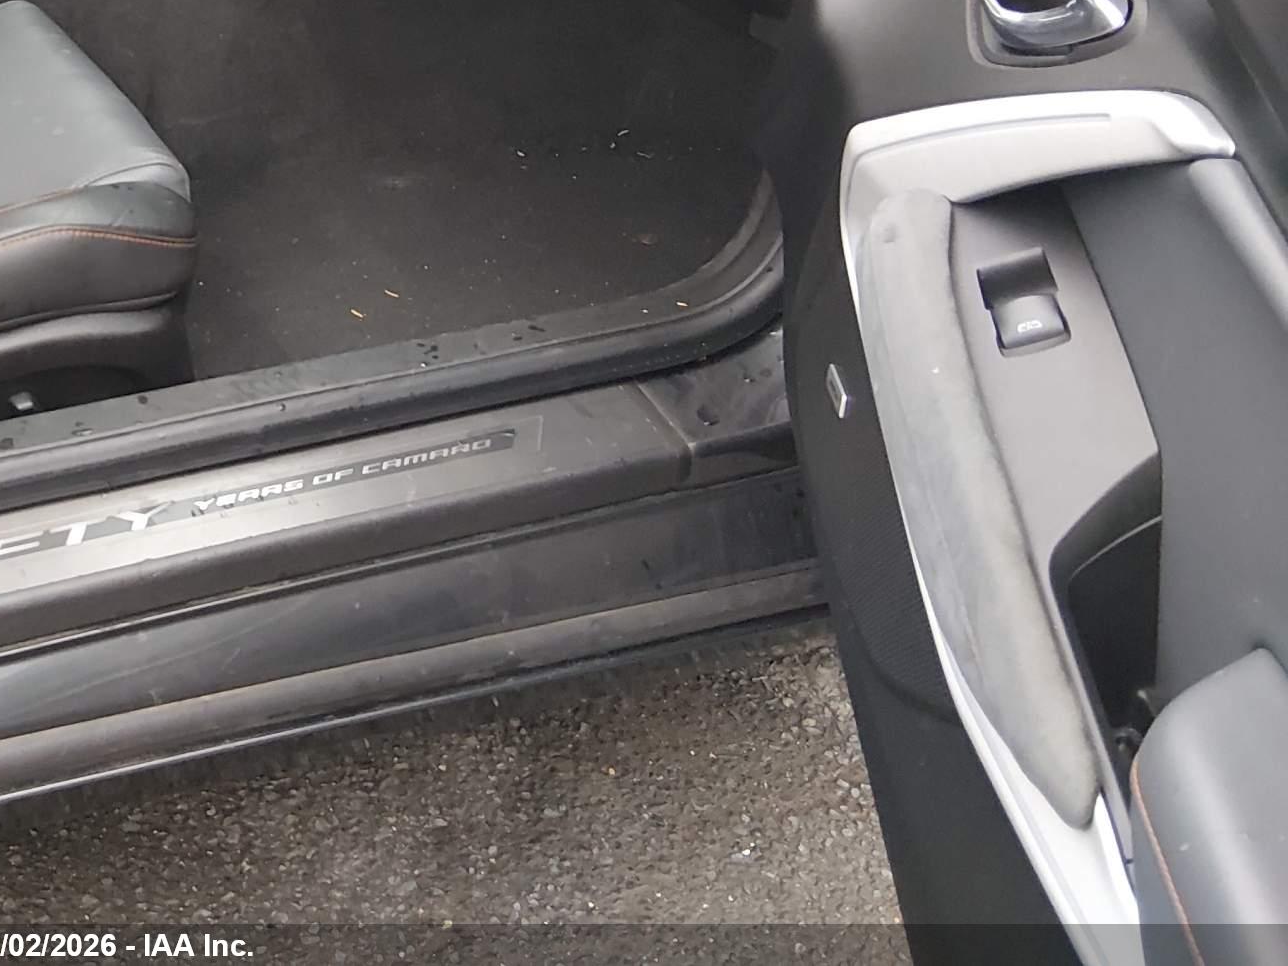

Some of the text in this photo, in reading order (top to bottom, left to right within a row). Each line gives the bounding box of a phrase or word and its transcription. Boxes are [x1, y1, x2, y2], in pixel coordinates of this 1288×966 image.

[193, 478, 304, 511] YEARS
[312, 468, 354, 486] OF
[361, 438, 492, 475] CAMARO
